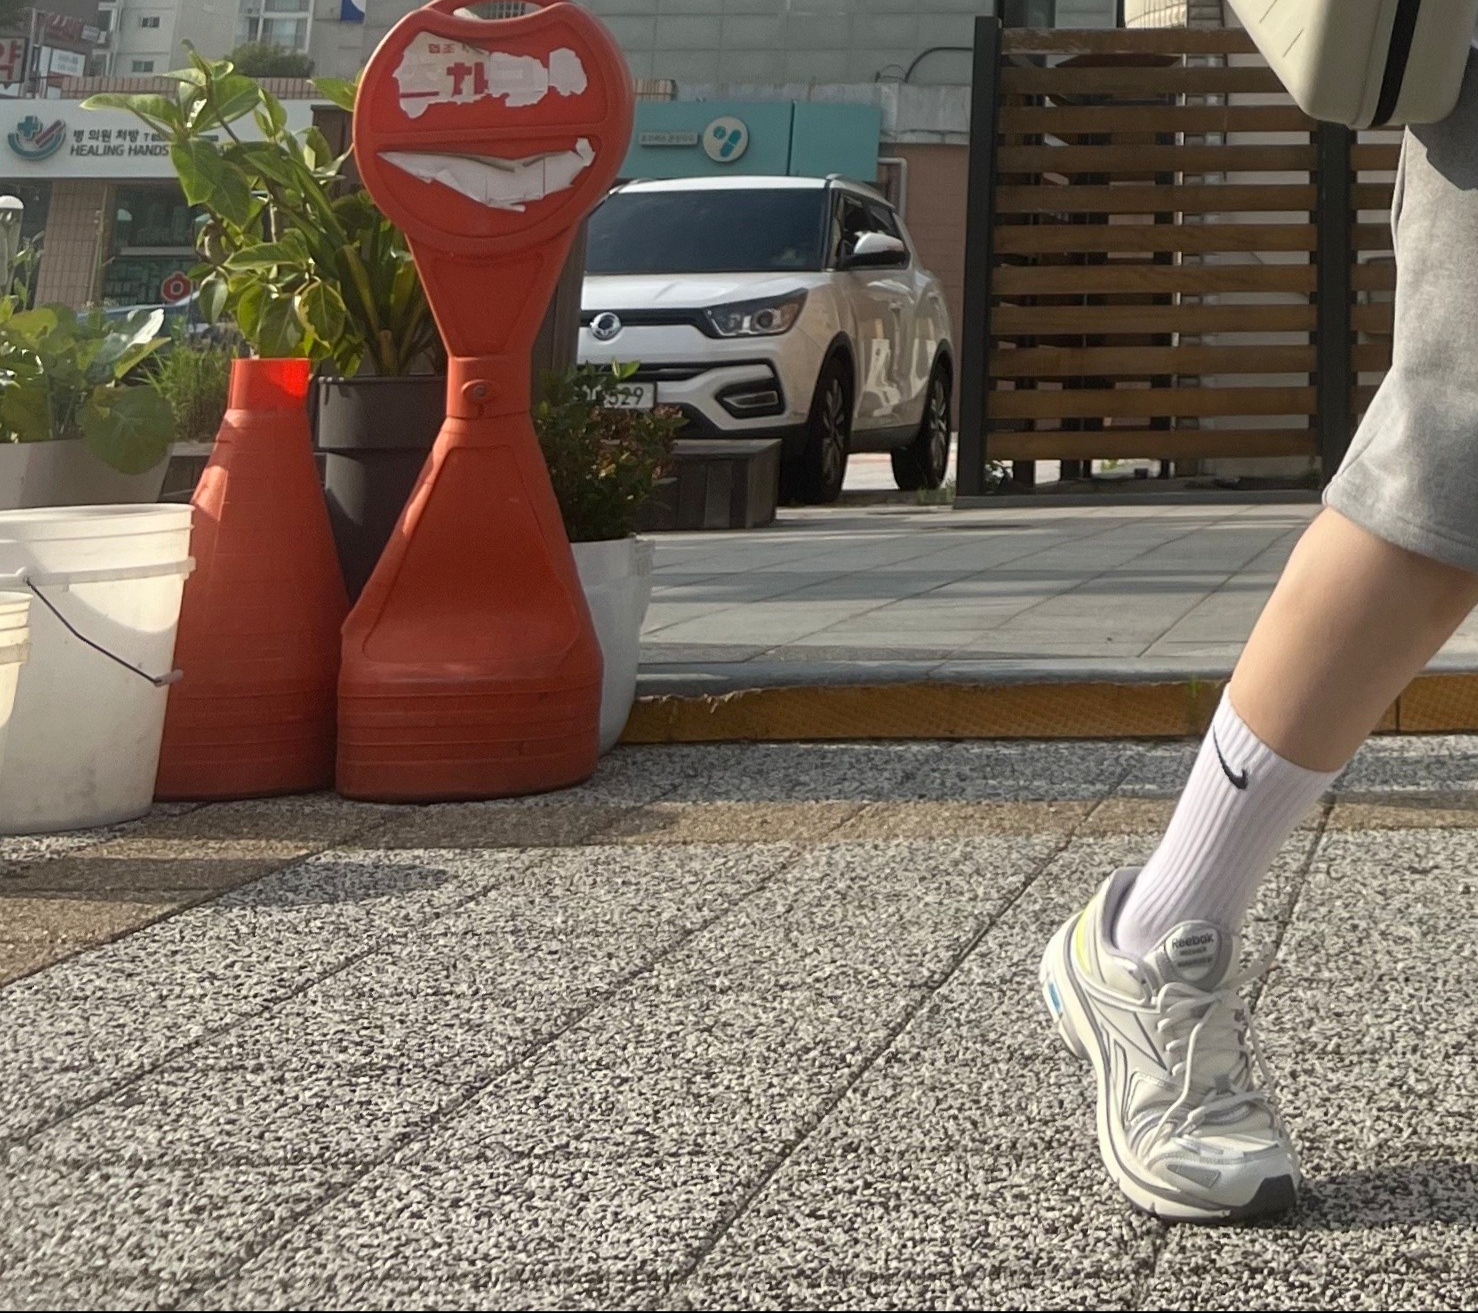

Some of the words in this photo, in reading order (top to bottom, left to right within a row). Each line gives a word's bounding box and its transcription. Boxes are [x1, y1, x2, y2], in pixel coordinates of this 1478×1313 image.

[70, 144, 124, 156] HEALING
[128, 144, 169, 156] HANDS
[1172, 933, 1213, 949] Reebok
